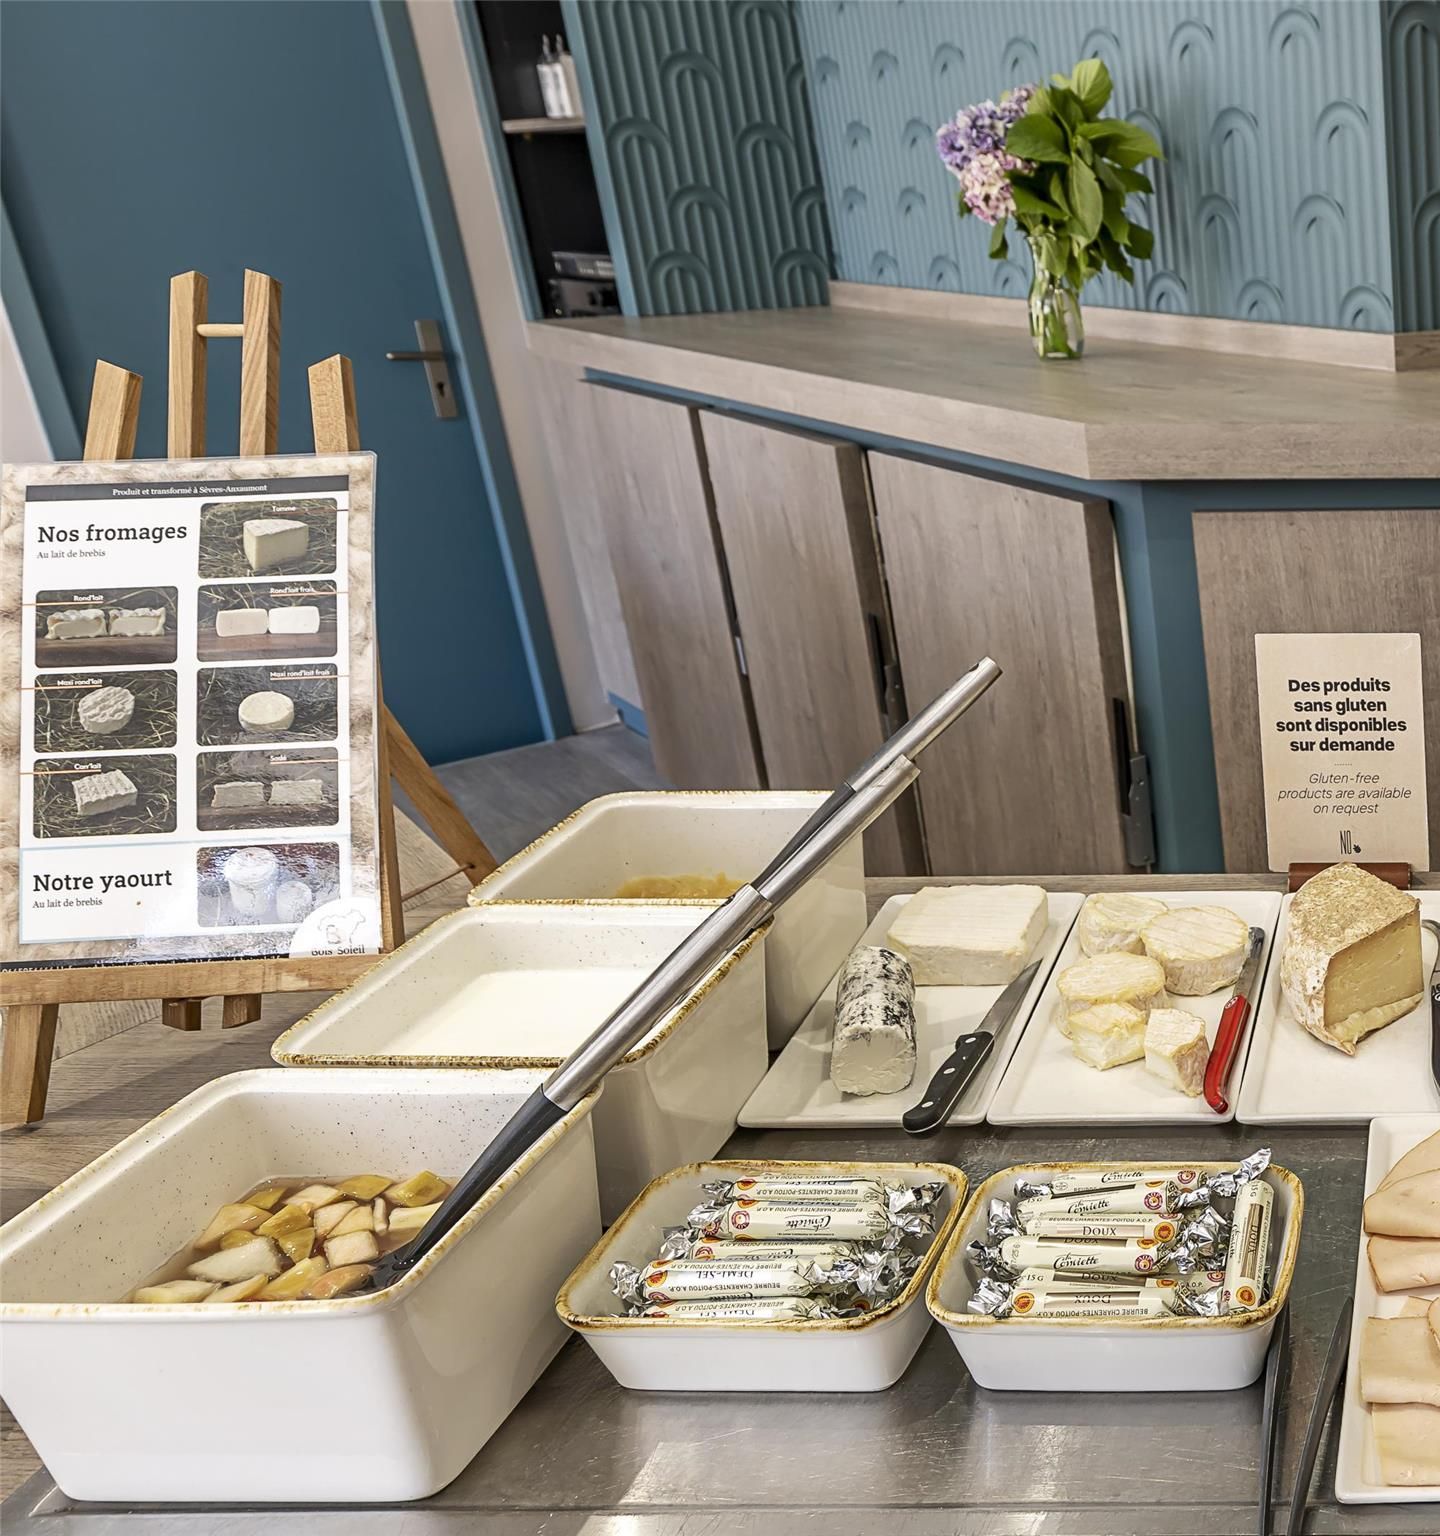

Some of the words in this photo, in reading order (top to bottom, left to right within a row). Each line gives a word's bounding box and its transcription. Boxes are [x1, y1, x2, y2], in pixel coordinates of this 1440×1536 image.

[112, 488, 141, 496] Produit
[151, 486, 192, 495] transformé
[193, 486, 198, 494] à
[38, 526, 79, 543] Nos
[86, 524, 187, 543] fromages
[51, 550, 64, 558] lait
[67, 550, 77, 558] de
[80, 549, 106, 557] brebis
[1288, 679, 1321, 692] Des
[1323, 678, 1391, 695] produits
[1294, 701, 1333, 712] sans
[1335, 698, 1387, 716] gluten
[1276, 719, 1312, 732] sont
[1315, 717, 1407, 735] disponibles
[1290, 740, 1316, 751] sur
[1319, 737, 1395, 751] demande
[1309, 773, 1380, 784] Gluten-free
[1277, 788, 1333, 801] products
[1335, 790, 1355, 799] are
[1358, 787, 1412, 799] available
[1313, 804, 1329, 814] on
[1332, 803, 1379, 816] request
[33, 874, 94, 892] Notre
[99, 870, 173, 893] yaourt
[32, 901, 45, 909] Au
[47, 899, 61, 908] lait
[63, 899, 74, 907] de
[76, 897, 103, 906] brebis
[337, 945, 365, 955] Soleil
[774, 1188, 833, 1196] CHARENTES-POITOU
[1082, 1225, 1117, 1236] DOUX
[1248, 1225, 1258, 1254] DOUX
[1081, 1273, 1118, 1281] DOUX
[688, 1283, 753, 1291] CHARENTES-POITOU
[1074, 1295, 1112, 1304] DOUX
[1123, 1308, 1149, 1316] BEURRE
